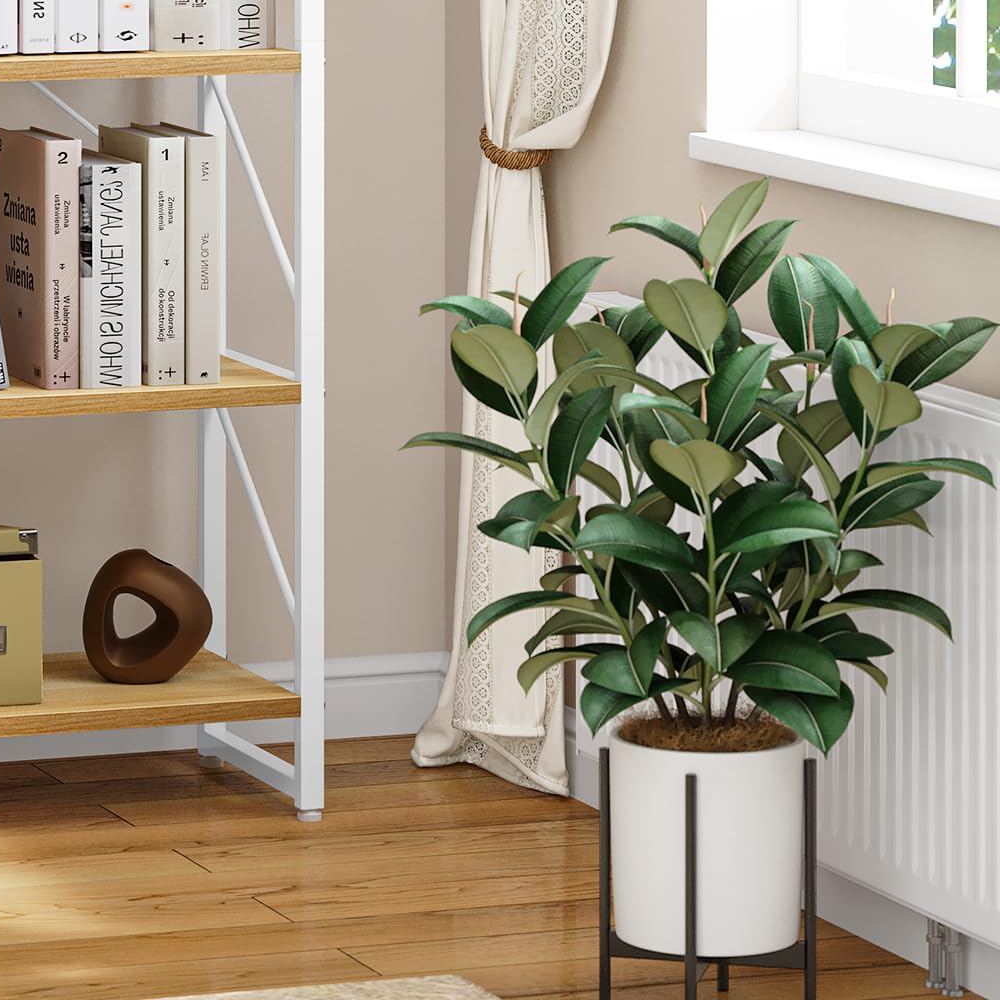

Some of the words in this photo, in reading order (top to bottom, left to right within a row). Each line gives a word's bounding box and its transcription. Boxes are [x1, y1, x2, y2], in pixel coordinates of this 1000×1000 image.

[238, 4, 260, 48] WHO
[58, 152, 68, 164] 2
[161, 148, 168, 160] 1
[4, 192, 36, 226] Zmiana
[10, 232, 30, 256] usta
[5, 260, 34, 292] wienia
[52, 279, 60, 322] przestrzeni
[158, 288, 166, 298] do
[168, 290, 176, 302] Od
[157, 300, 166, 342] konstrukcji
[166, 302, 176, 339] dekoracji
